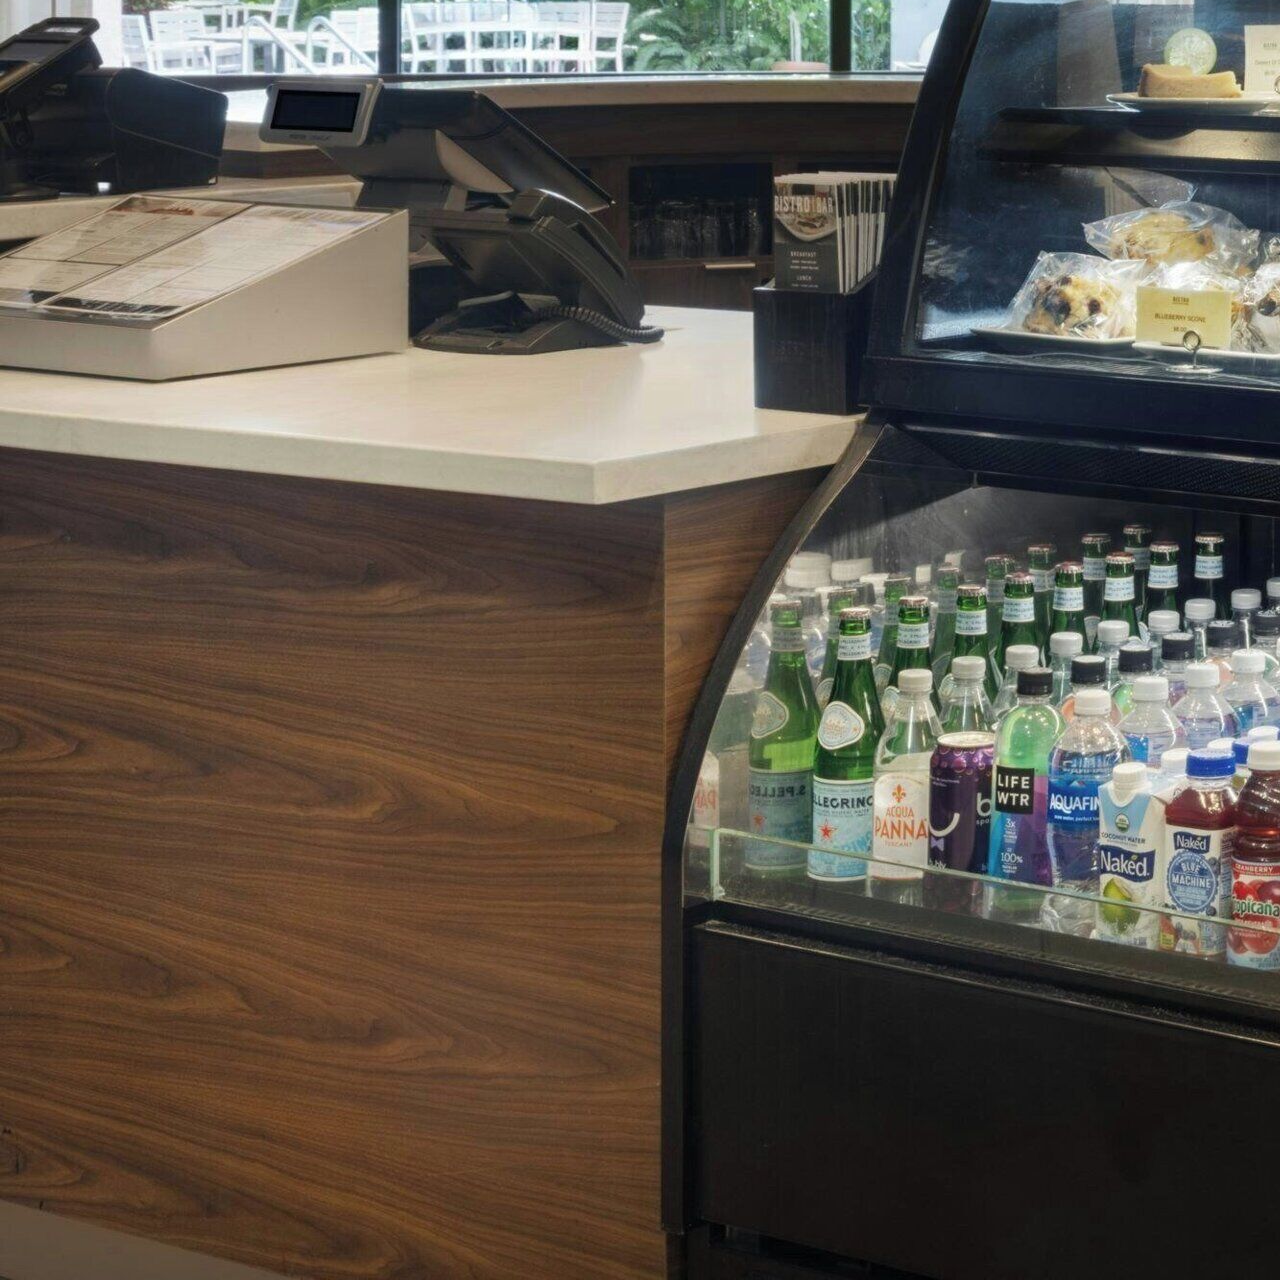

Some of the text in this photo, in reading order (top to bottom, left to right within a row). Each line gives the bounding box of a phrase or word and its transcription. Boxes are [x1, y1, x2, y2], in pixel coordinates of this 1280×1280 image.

[774, 195, 834, 214] BISTRO BAR
[790, 250, 817, 258] BREAKFAST
[1154, 313, 1206, 323] BLUEBERRY SCONE
[997, 773, 1030, 790] LIFE
[997, 793, 1030, 807] WTR
[1050, 793, 1100, 814] AQUAFIN
[885, 805, 914, 818] ACQUA
[875, 817, 929, 839] PANNA
[1101, 831, 1146, 844] COCONUT WATER
[1176, 835, 1207, 851] Naked
[1000, 852, 1023, 864] 100%
[1181, 861, 1201, 874] BLUE
[1235, 863, 1274, 873] CRANBERRY
[1172, 873, 1212, 889] MACHINE
